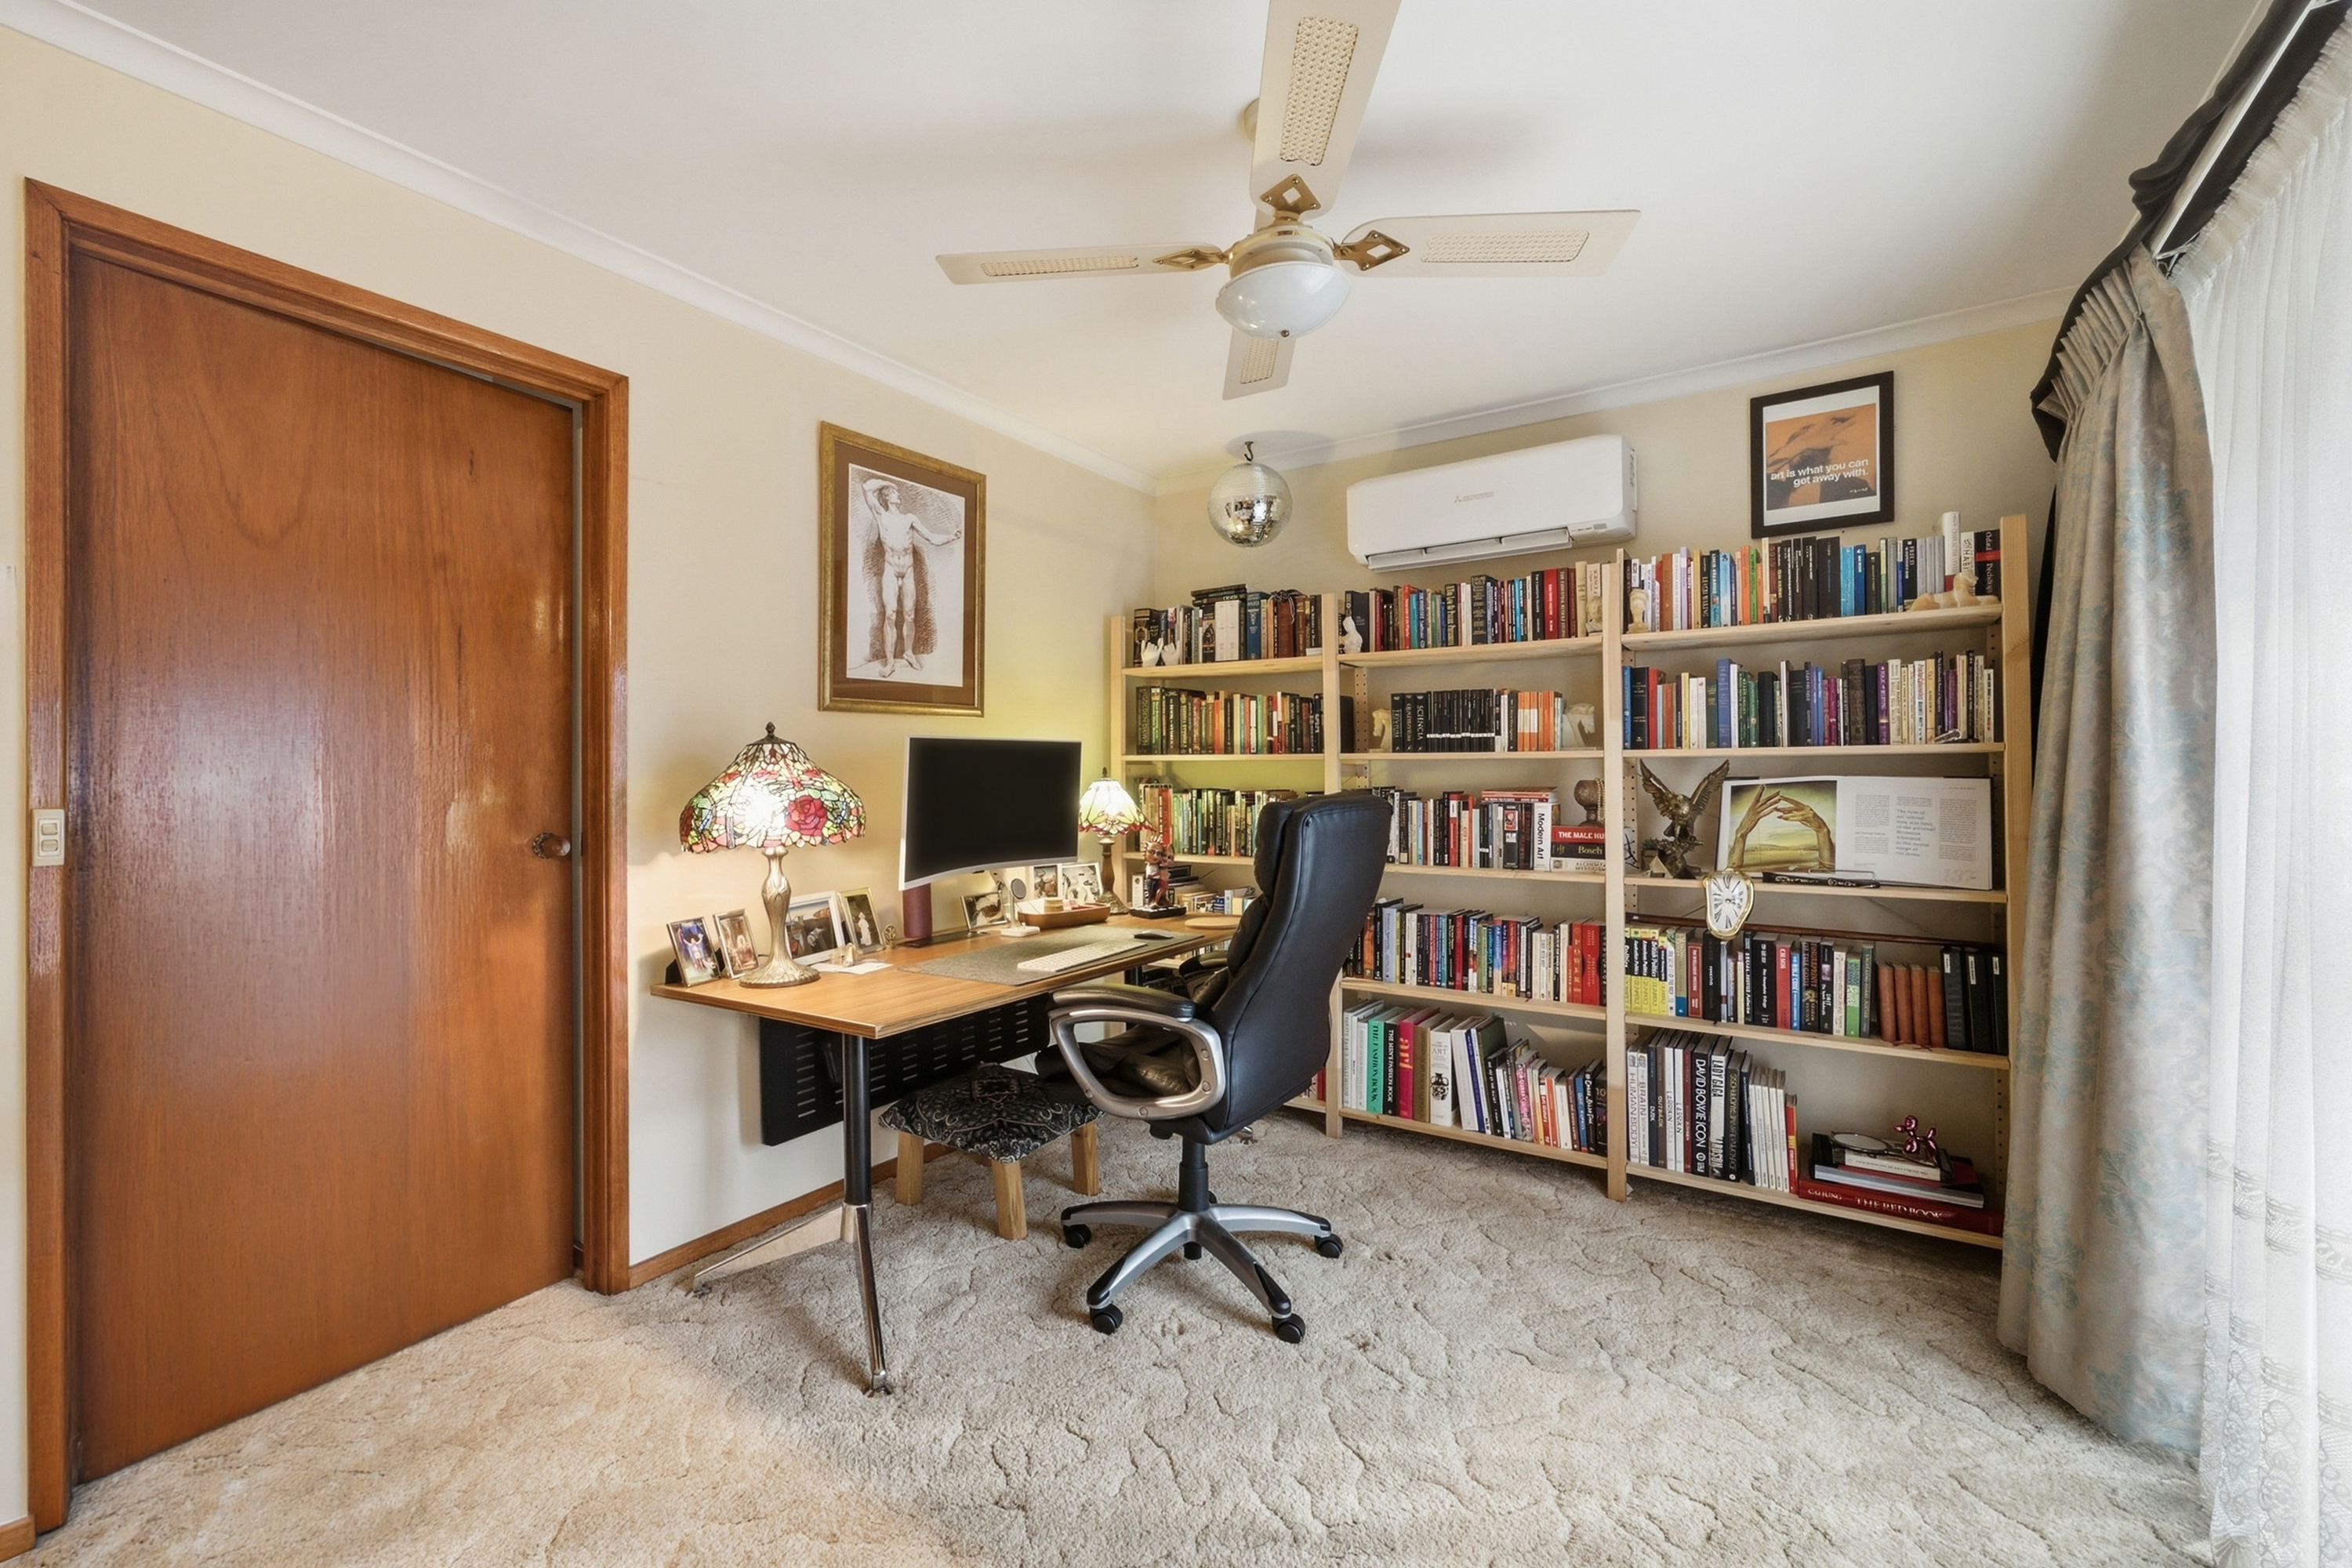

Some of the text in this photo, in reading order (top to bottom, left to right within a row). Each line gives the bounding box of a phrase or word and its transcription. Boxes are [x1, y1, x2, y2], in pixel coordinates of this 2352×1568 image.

[1786, 469, 1795, 478] is
[1798, 465, 1824, 477] what
[1825, 463, 1846, 474] you
[1849, 459, 1869, 468] can
[1794, 468, 1869, 488] get away with.
[1578, 846, 1602, 855] Bosch
[1399, 1037, 1413, 1069] art
[1712, 1060, 1724, 1098] LADY GAGA
[1629, 1073, 1639, 1147] HUMAN BODY
[1695, 1059, 1706, 1147] DAVID BOWIE ICON
[1855, 1196, 1879, 1208] THE
[1883, 1202, 1907, 1214] RED
[1910, 1208, 1943, 1220] BOOK
